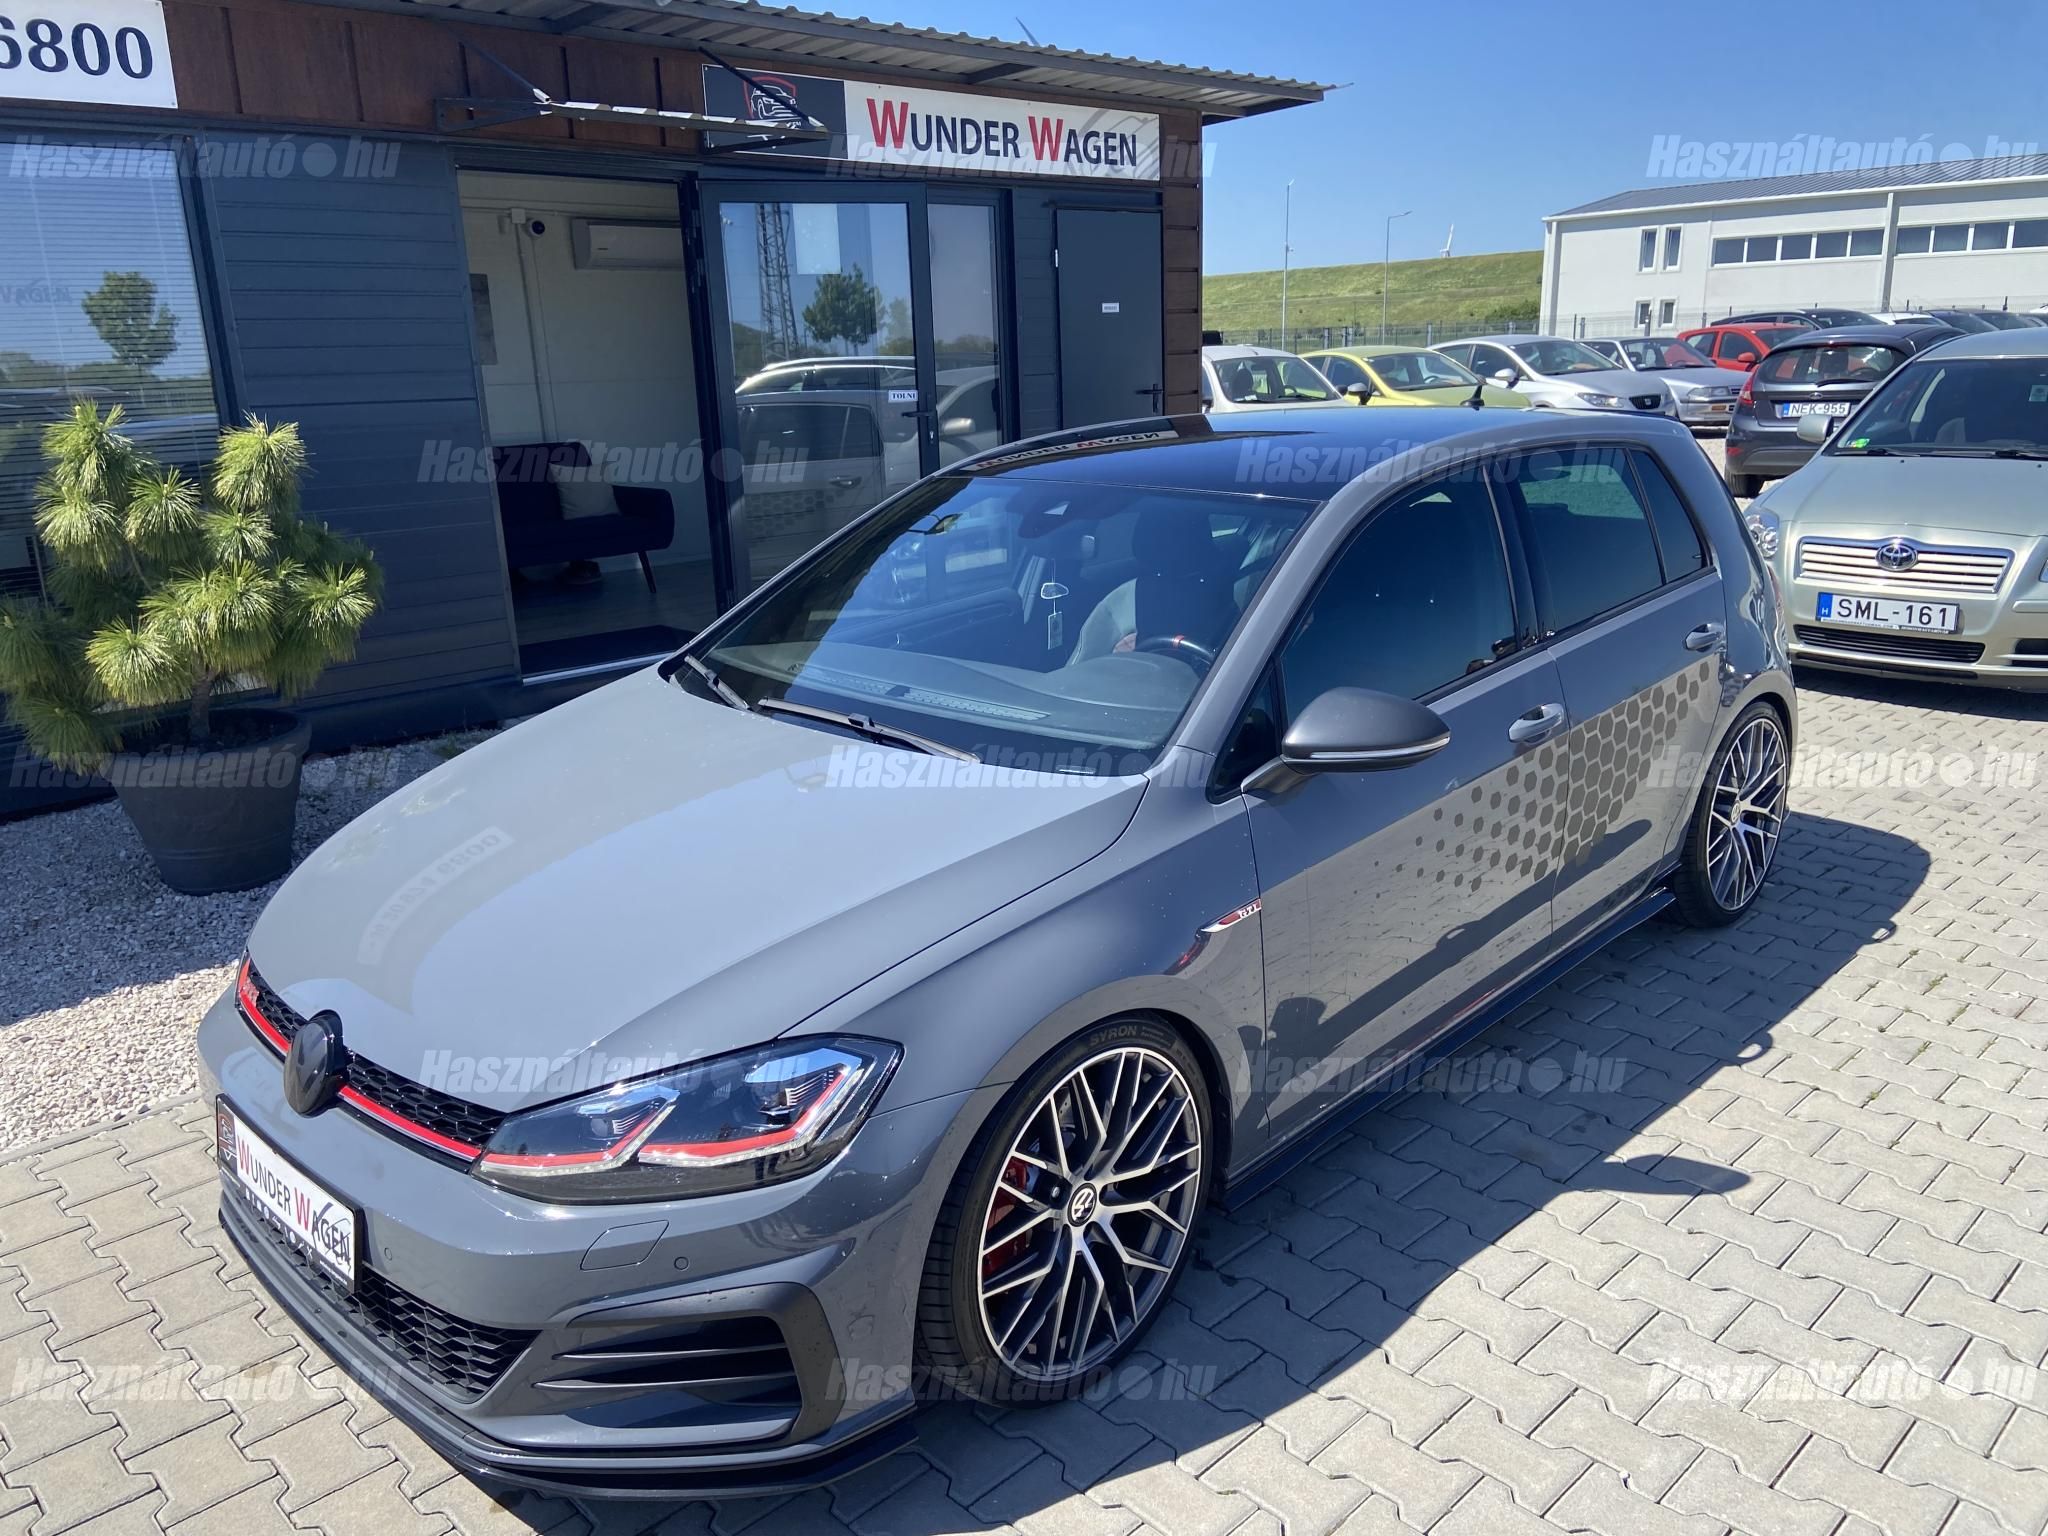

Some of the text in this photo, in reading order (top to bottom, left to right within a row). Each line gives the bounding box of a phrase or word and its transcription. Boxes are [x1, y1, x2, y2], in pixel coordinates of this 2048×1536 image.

[866, 97, 1137, 167] WUNDER WAGEN
[1791, 403, 1846, 414] NEK-955
[1837, 598, 1947, 627] SML-161
[1089, 1025, 1138, 1047] SYRON
[236, 1135, 292, 1217] WUNDER
